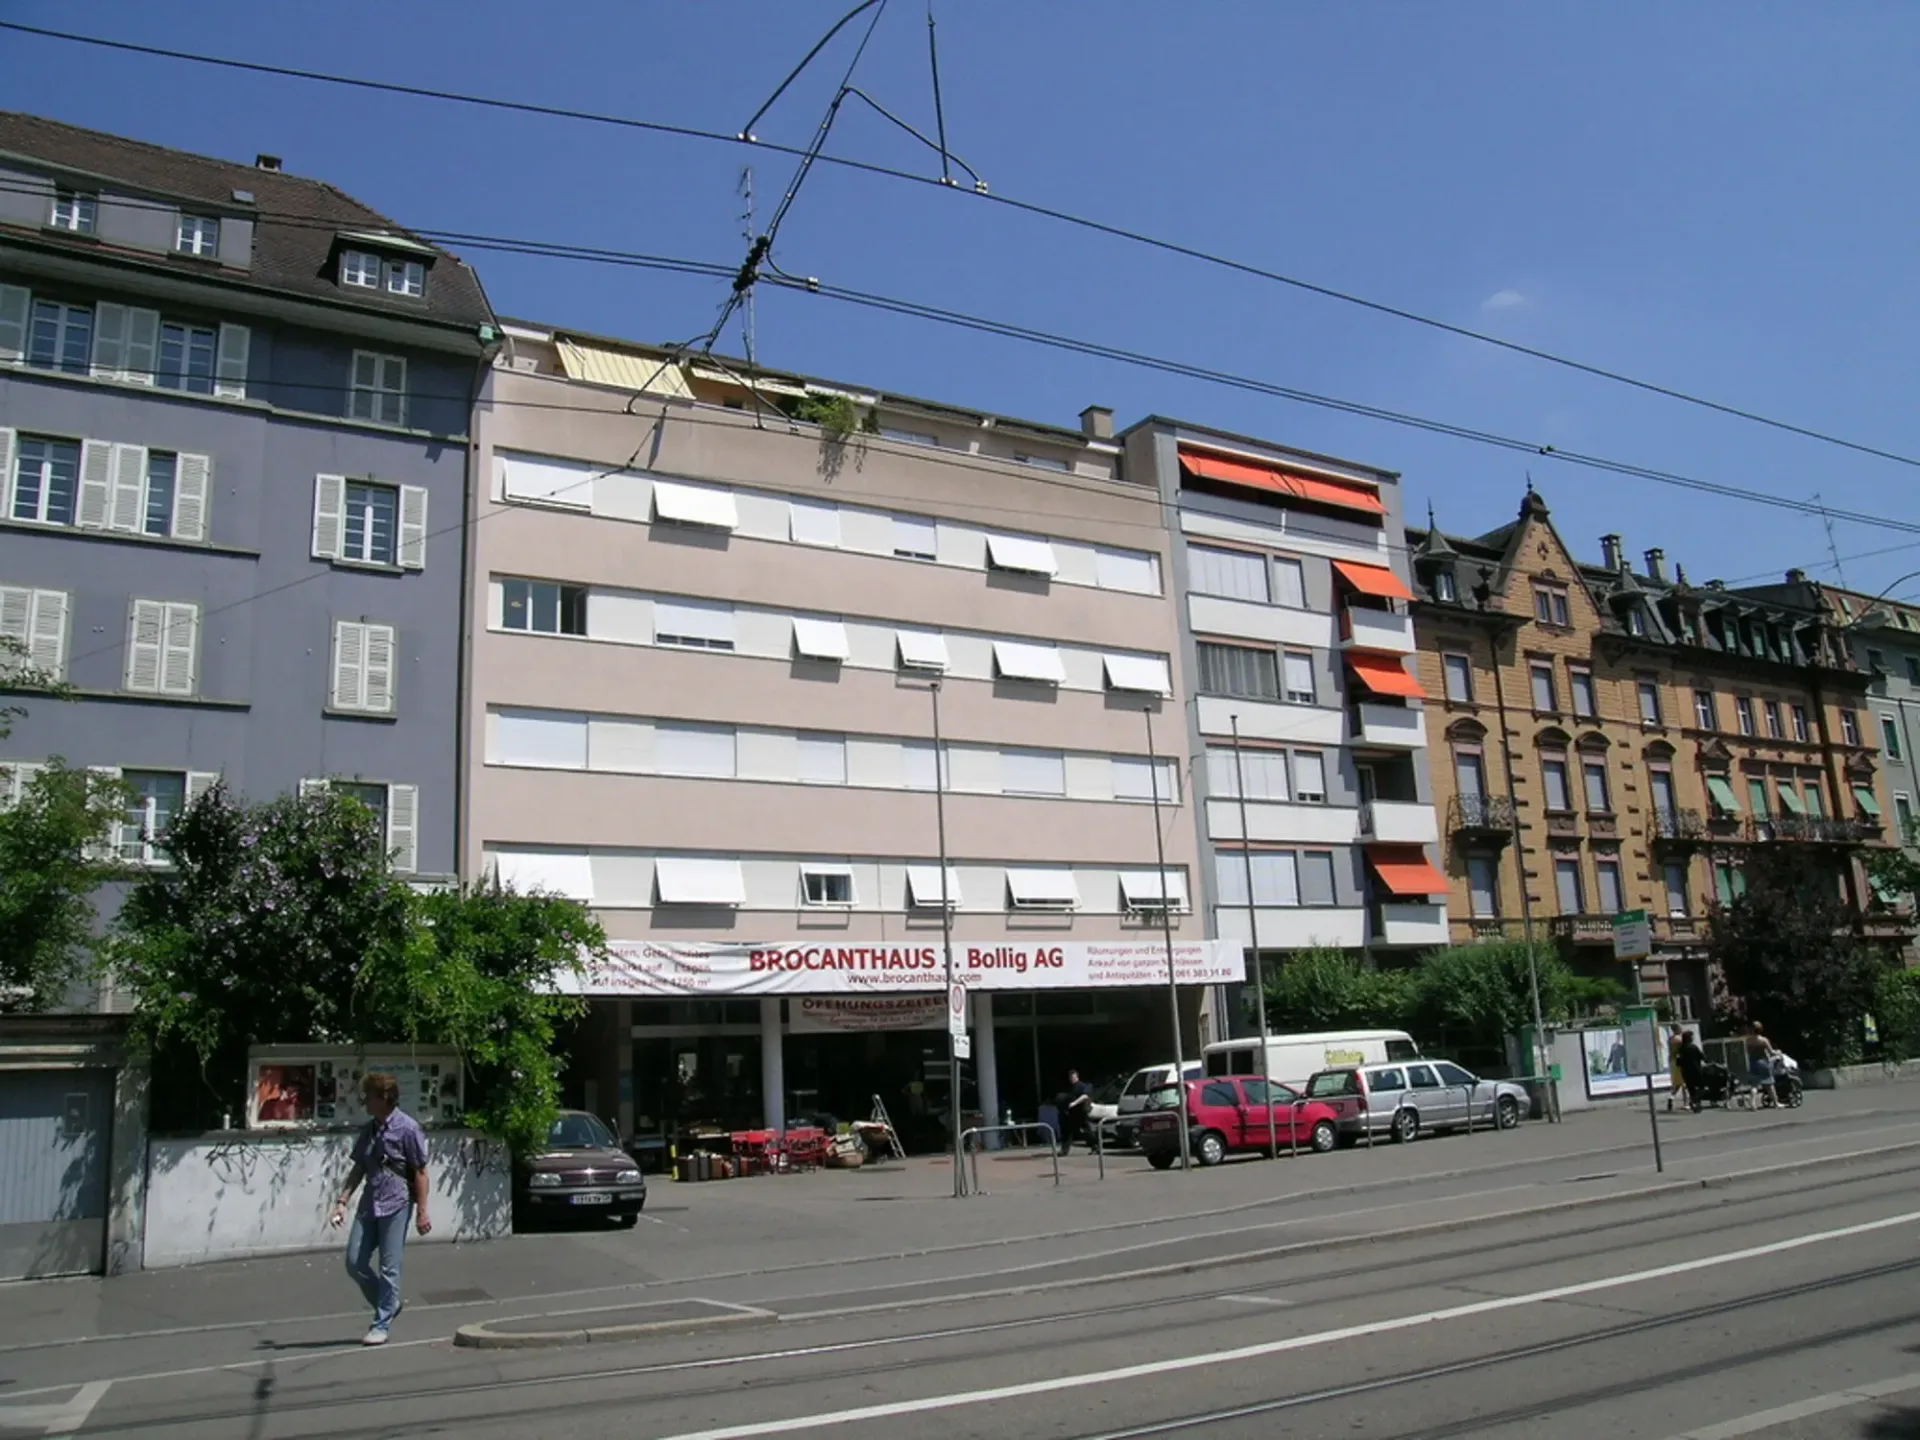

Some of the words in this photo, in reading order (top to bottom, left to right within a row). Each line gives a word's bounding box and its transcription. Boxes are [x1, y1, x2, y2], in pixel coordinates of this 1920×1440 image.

[749, 948, 936, 972] BROCANTHAUS
[967, 947, 1028, 972] Bollig
[1034, 947, 1065, 969] AG
